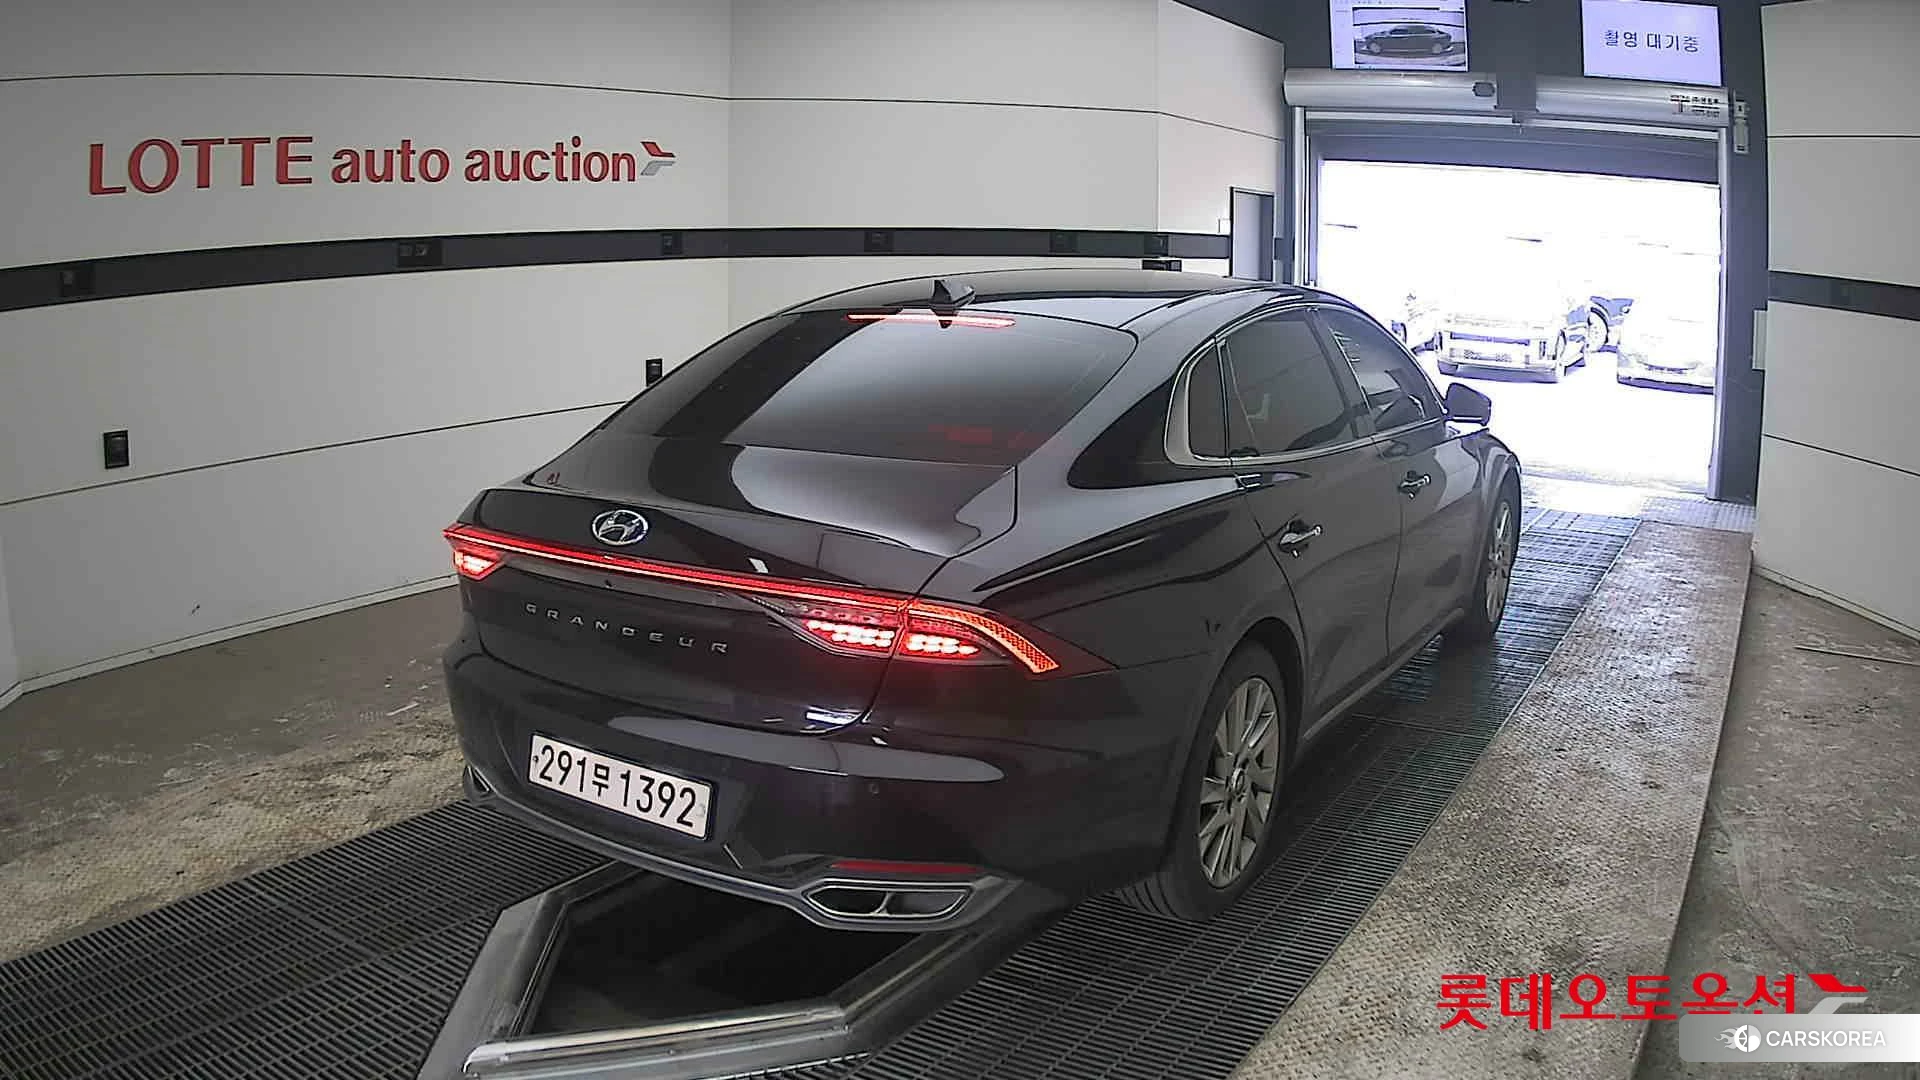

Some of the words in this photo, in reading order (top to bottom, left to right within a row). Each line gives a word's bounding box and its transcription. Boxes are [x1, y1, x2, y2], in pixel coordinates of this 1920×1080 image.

[1646, 33, 1698, 53] 대기중
[89, 136, 314, 196] LOTTE
[331, 139, 450, 184] auto
[465, 136, 637, 183] auction
[525, 603, 728, 653] GRANDEUR
[539, 744, 610, 797] 291무
[620, 769, 697, 828] 1392
